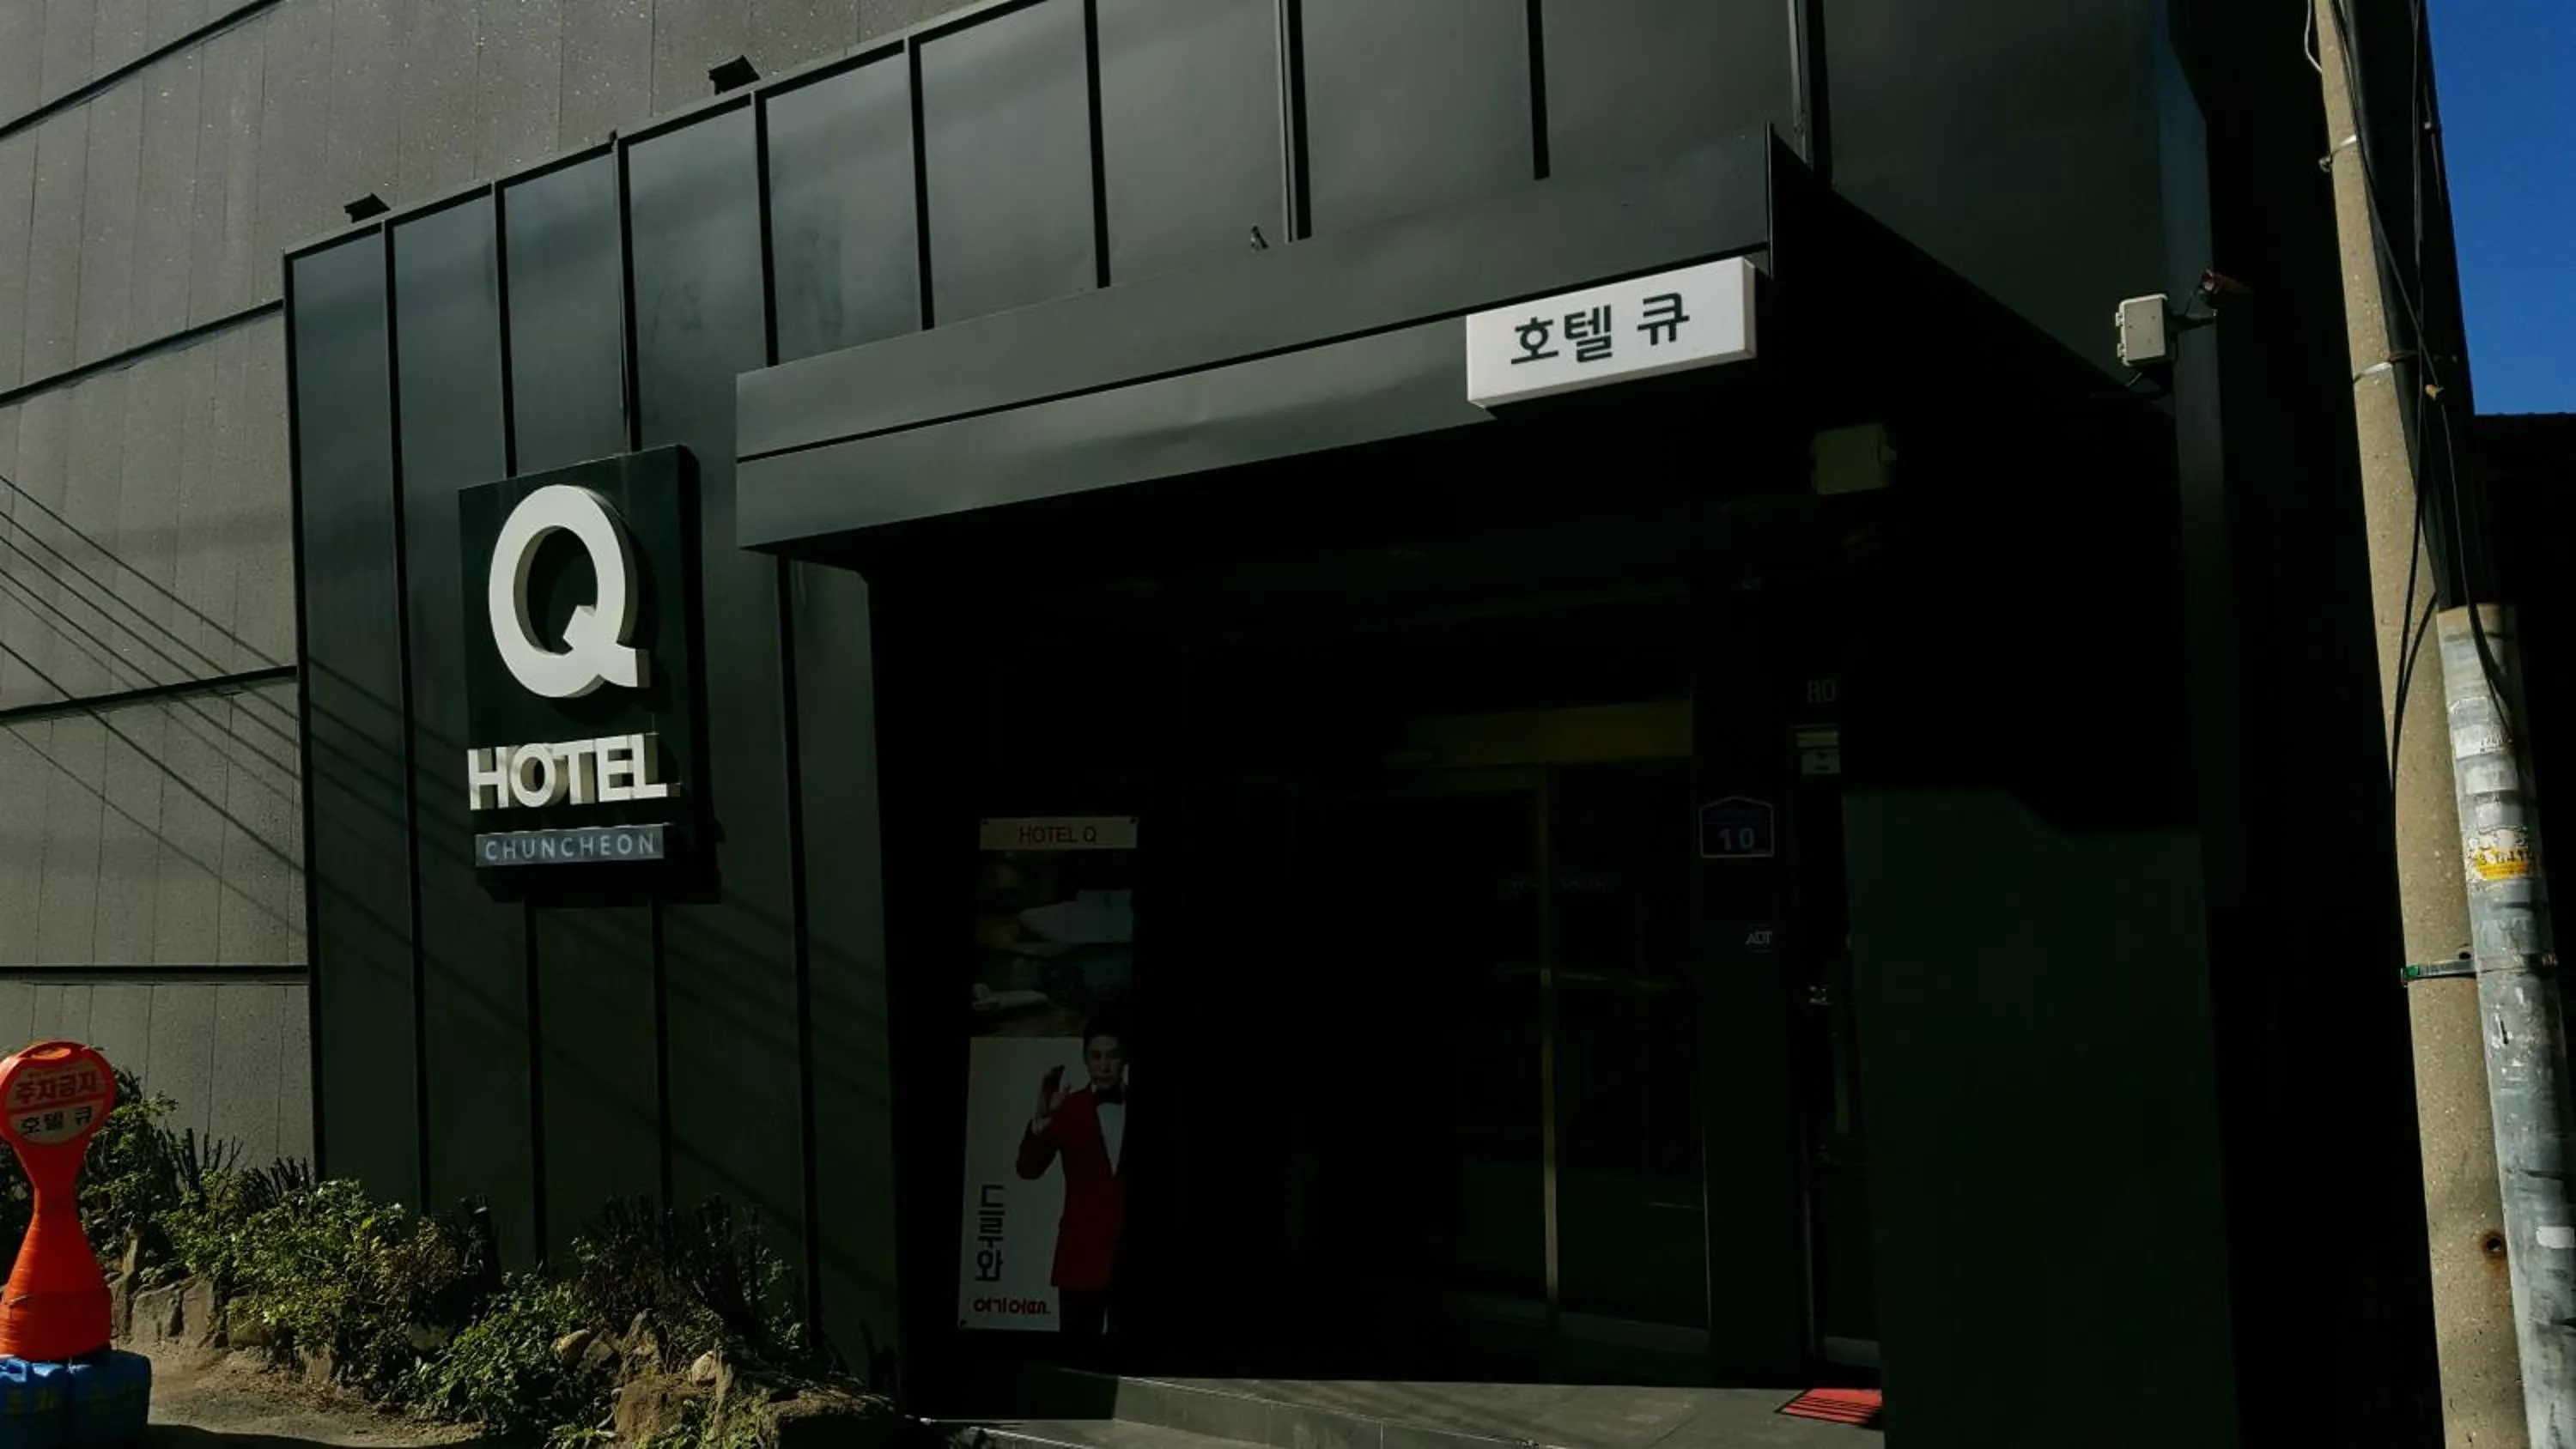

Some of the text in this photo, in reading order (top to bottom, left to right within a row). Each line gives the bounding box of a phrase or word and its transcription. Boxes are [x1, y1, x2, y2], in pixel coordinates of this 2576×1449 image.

[1510, 292, 1690, 365] 호텔 큐
[488, 483, 651, 700] Q
[467, 732, 682, 811] HOTEL
[484, 833, 655, 861] CHUNCHEON
[1018, 826, 1097, 843] HOTEL Q
[1717, 827, 1756, 851] 10
[1745, 931, 1773, 945] ADT
[21, 1106, 92, 1134] 호텔 큐
